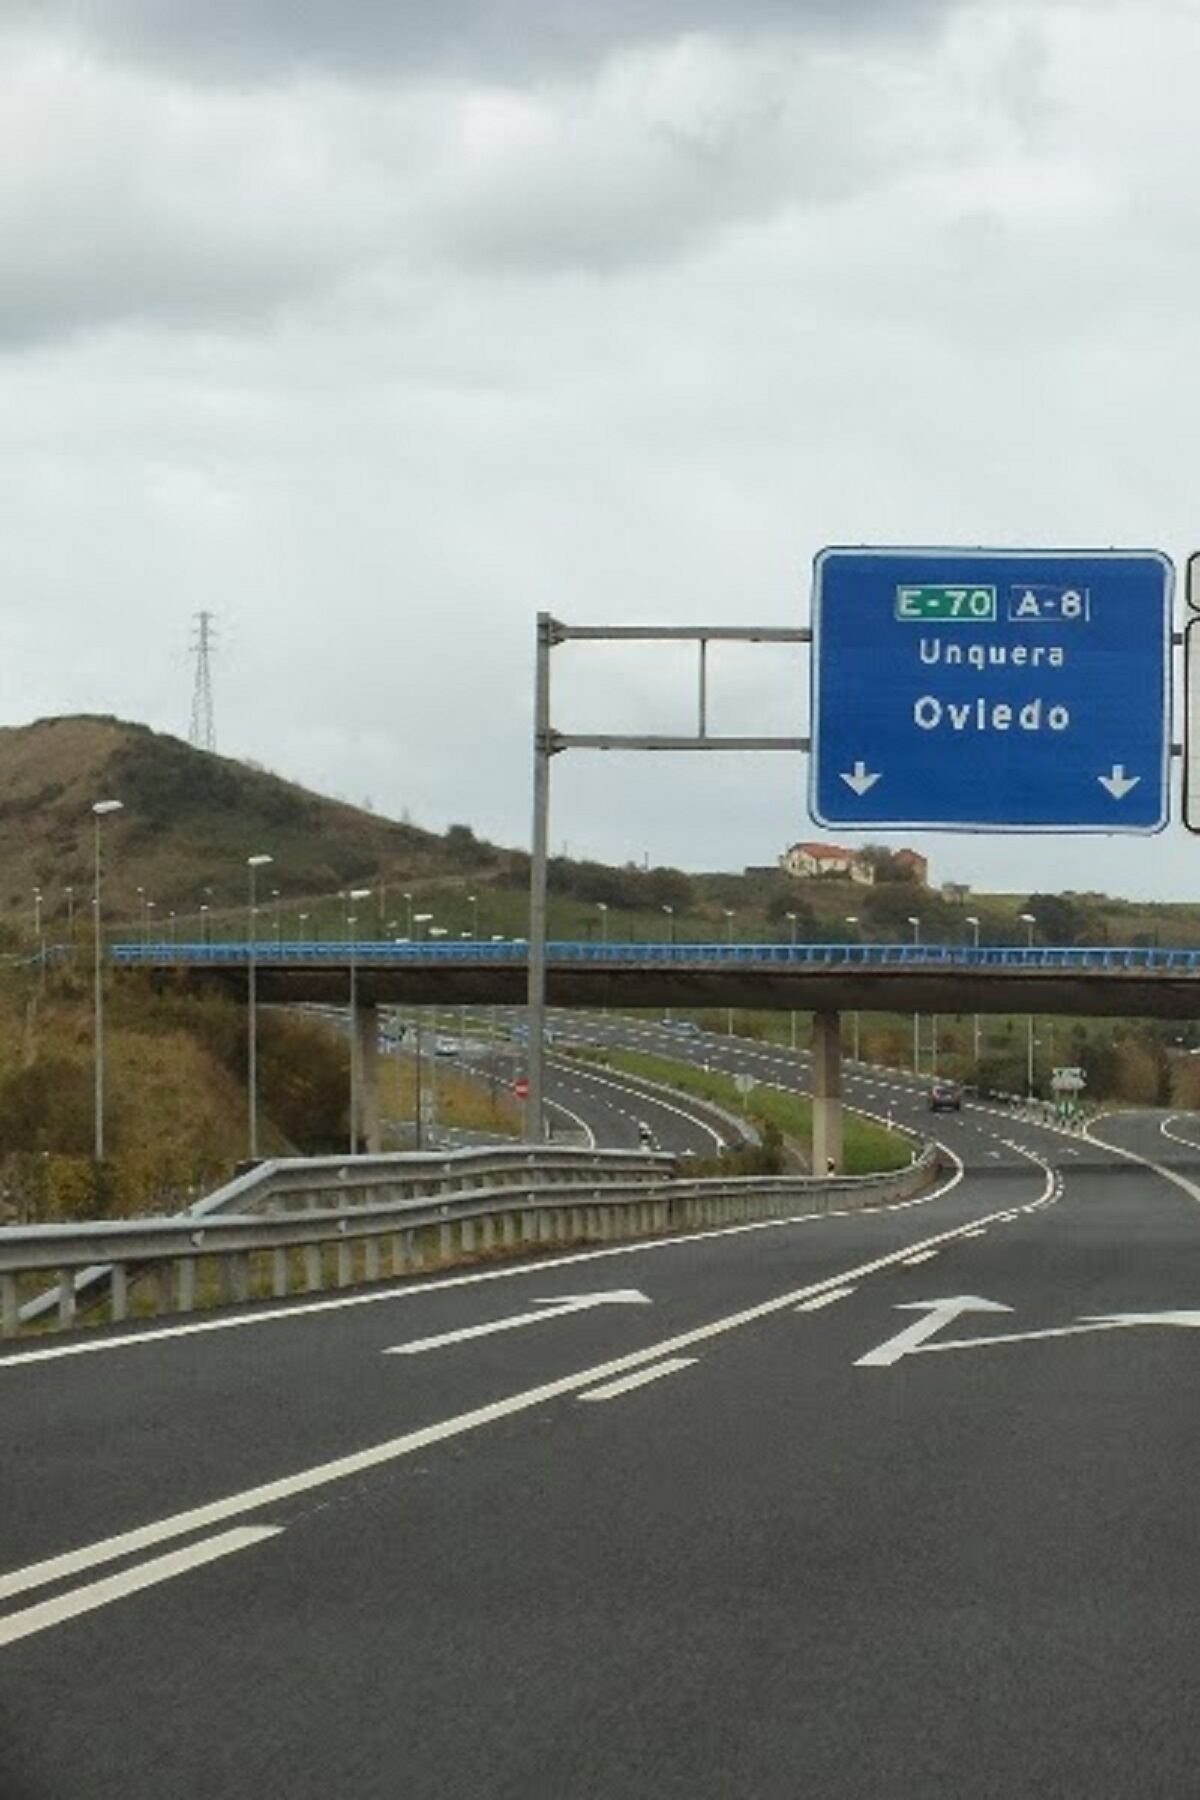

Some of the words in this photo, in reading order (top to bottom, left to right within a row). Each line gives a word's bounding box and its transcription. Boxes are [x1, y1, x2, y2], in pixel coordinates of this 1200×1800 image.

[900, 589, 991, 616] E-70
[1016, 590, 1081, 617] A-8
[920, 639, 1064, 671] Unquera
[914, 696, 1069, 730] Oviedo
